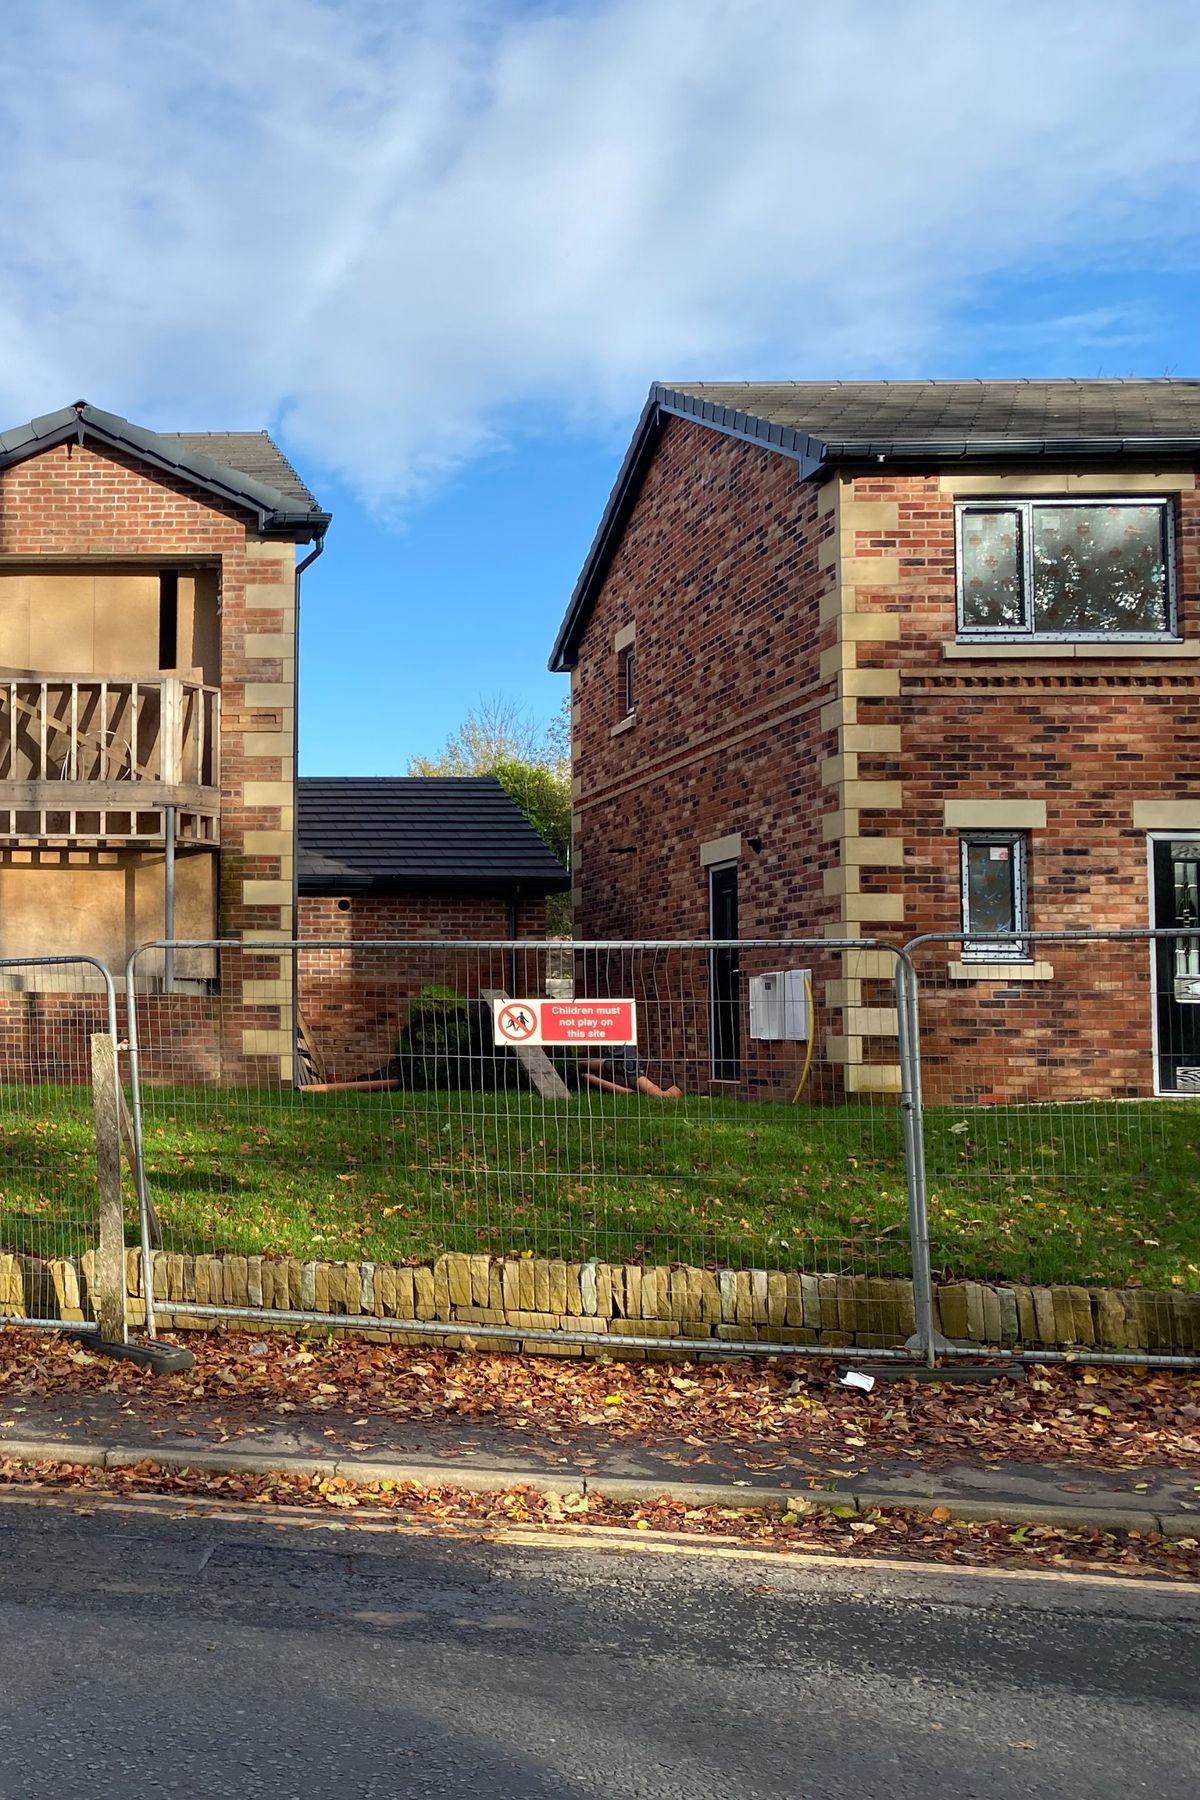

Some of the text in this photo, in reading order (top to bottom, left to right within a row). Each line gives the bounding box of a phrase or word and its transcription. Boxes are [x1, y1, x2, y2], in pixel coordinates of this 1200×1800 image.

[551, 1006, 621, 1015] Children must
[577, 1018, 598, 1028] play
[567, 1030, 606, 1038] this site
